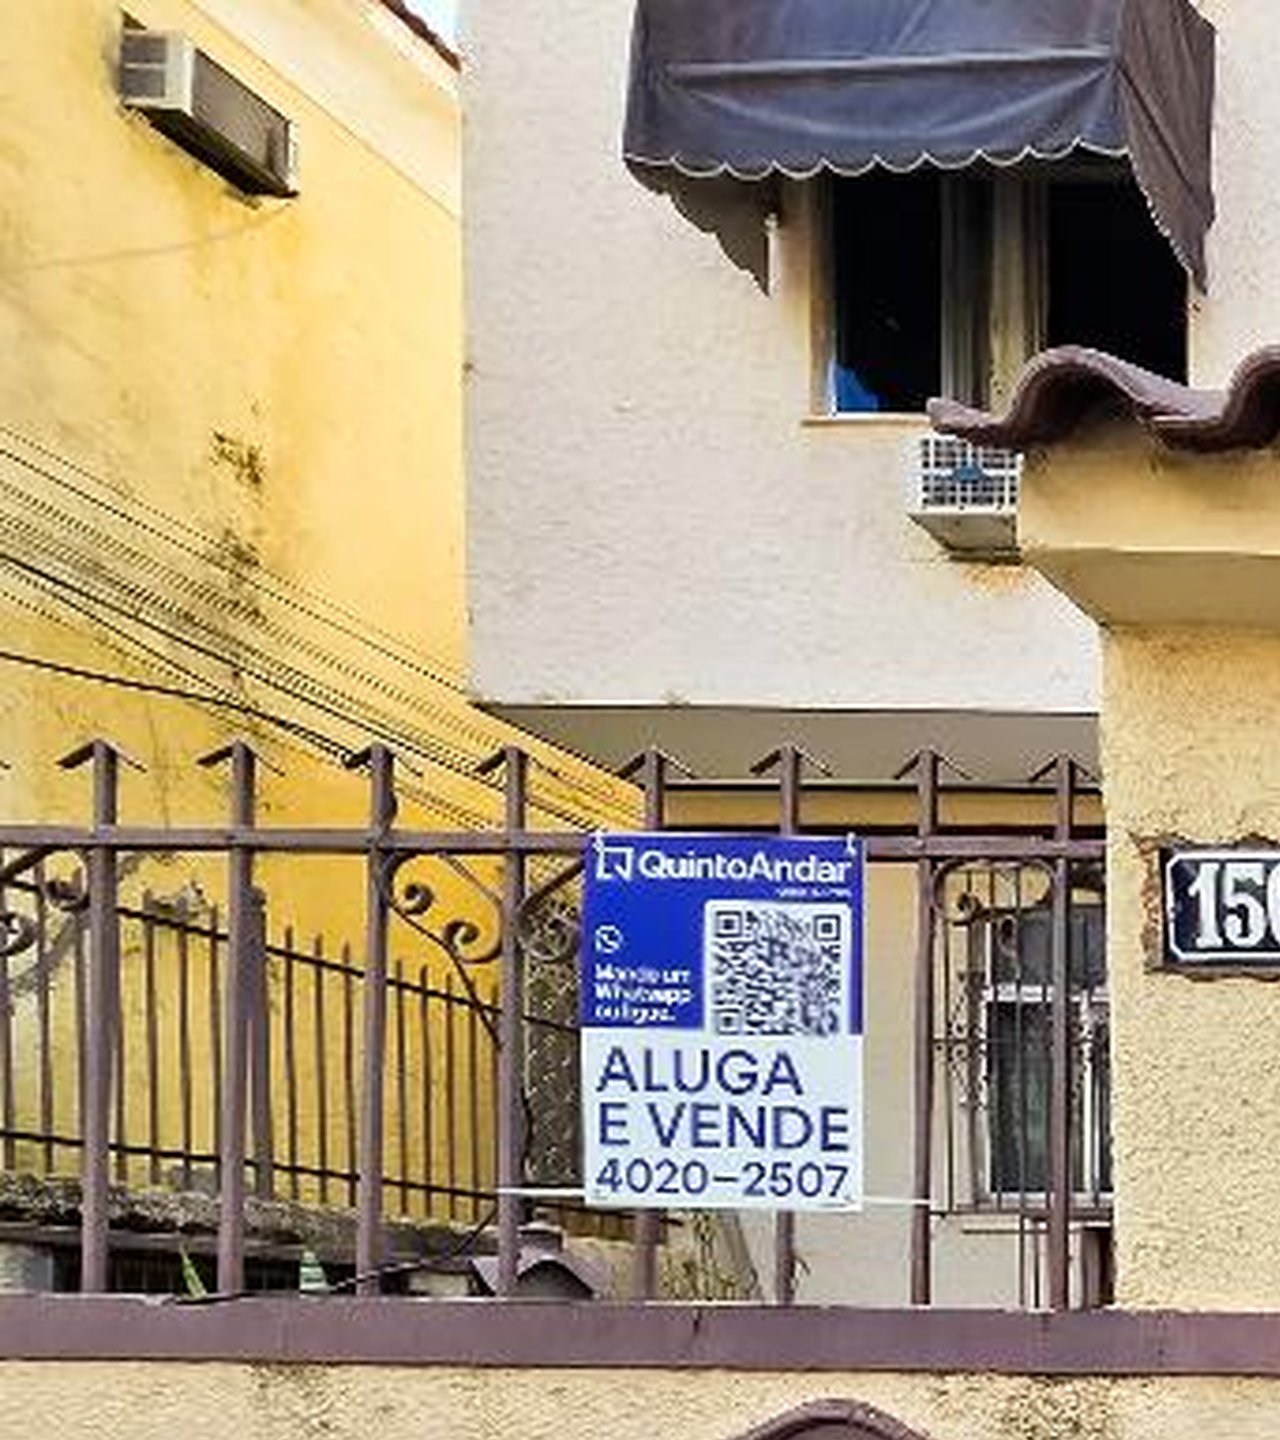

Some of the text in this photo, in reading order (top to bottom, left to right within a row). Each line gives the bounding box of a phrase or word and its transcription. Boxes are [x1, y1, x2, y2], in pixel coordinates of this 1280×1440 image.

[638, 850, 852, 883] QuintoAndar
[596, 1046, 804, 1096] ALUGA
[599, 1102, 850, 1152] E VENDE
[596, 1157, 850, 1198] 4020-2507
